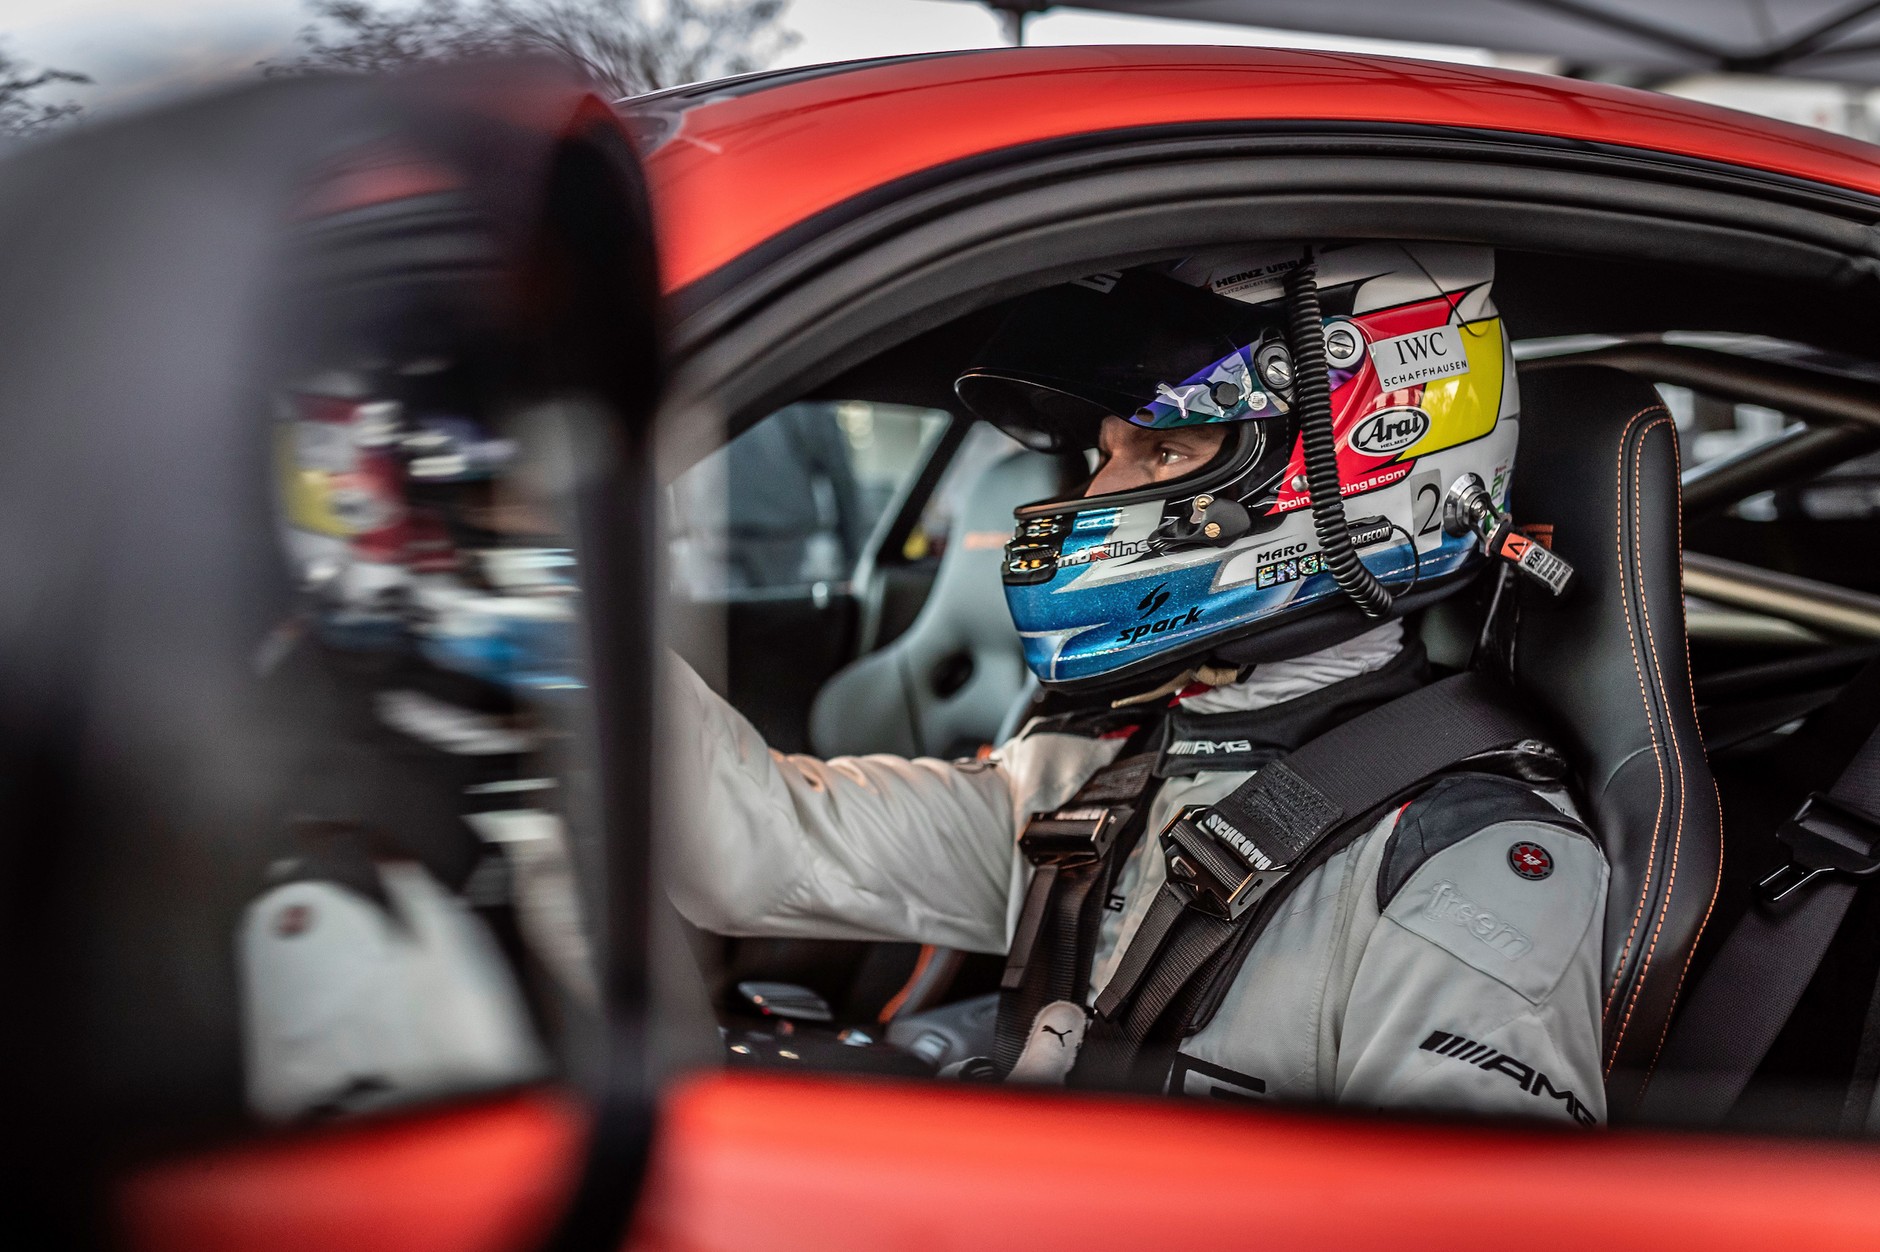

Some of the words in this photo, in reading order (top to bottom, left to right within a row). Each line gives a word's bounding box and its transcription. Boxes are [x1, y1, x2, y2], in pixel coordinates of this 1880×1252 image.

[1215, 268, 1264, 288] HEINZ
[1394, 332, 1448, 365] IWC
[1384, 360, 1467, 387] SCHAFFHAUSEN
[1359, 411, 1421, 447] Arai
[1380, 437, 1409, 449] HELMET
[1417, 483, 1442, 537] 2
[1351, 526, 1390, 546] RACECOM
[1257, 543, 1308, 563] MARO
[1116, 606, 1206, 644] spark
[1193, 740, 1252, 754] AMG
[1204, 813, 1272, 870] SCHROTH
[1423, 879, 1533, 961] freem
[1479, 1053, 1598, 1129] AMG
